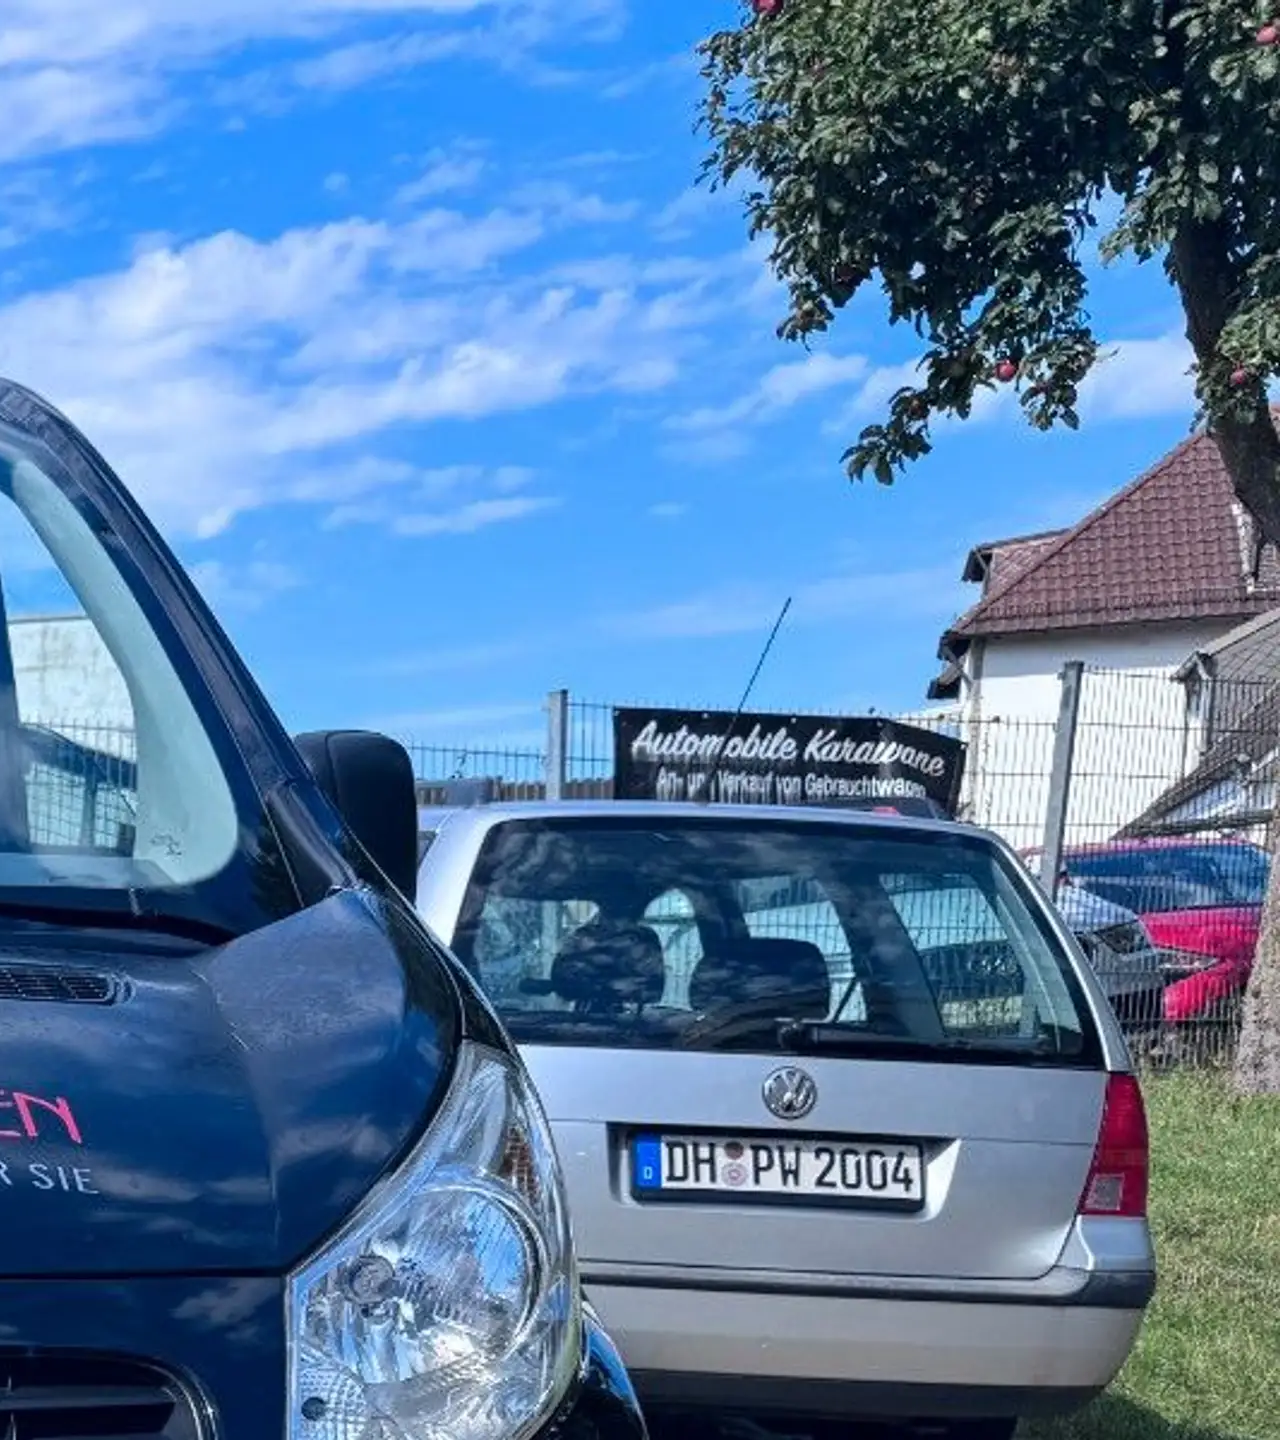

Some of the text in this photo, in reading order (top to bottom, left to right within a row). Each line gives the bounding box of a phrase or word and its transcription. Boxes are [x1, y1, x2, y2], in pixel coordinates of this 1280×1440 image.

[630, 719, 946, 777] Automobile Karawane
[716, 768, 772, 797] Verkauf
[776, 776, 802, 798] von
[804, 772, 927, 799] Gebrauchtwagen
[30, 1164, 100, 1195] SIE
[643, 1141, 914, 1193] D DH PW 2004
